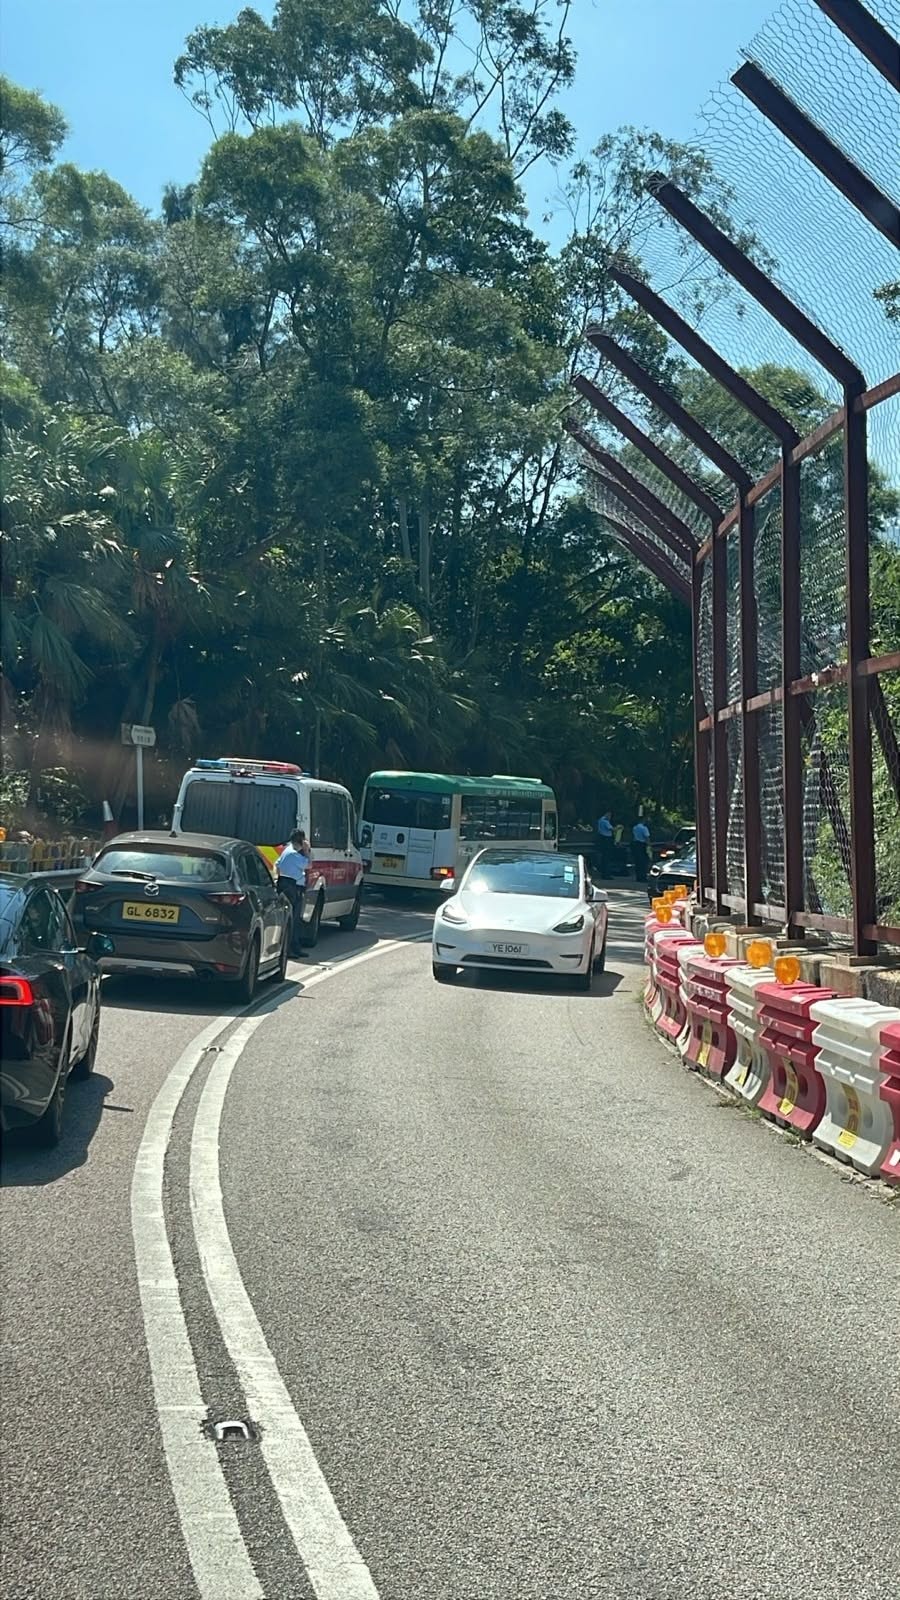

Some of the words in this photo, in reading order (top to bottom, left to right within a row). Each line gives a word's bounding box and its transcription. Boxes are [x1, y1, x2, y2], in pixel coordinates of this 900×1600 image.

[127, 906, 141, 917] GL
[144, 907, 175, 920] 6832
[492, 944, 504, 953] YE
